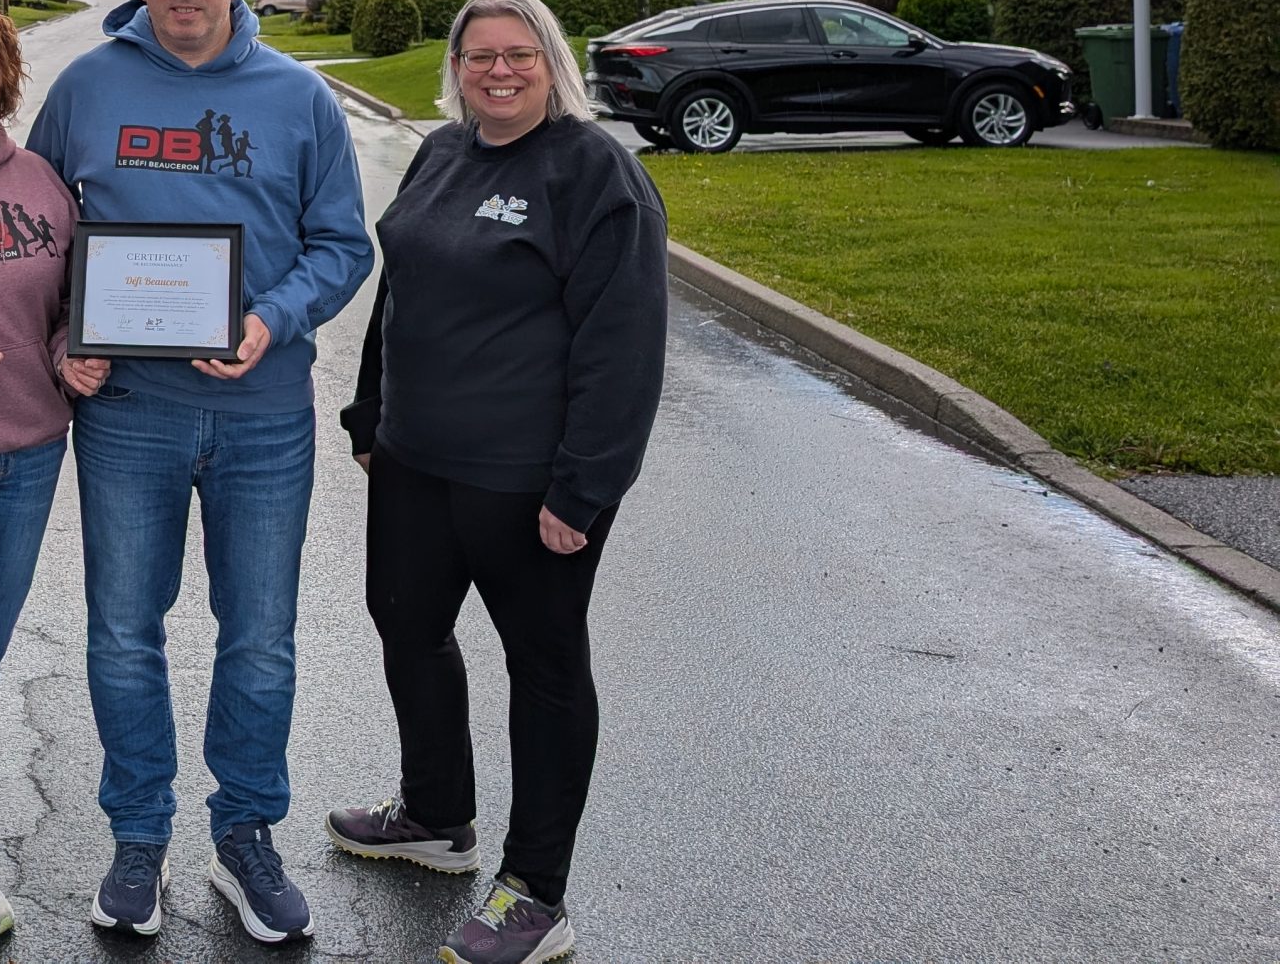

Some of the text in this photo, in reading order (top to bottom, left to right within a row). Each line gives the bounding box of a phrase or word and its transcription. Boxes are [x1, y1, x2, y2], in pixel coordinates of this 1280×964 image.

[119, 126, 202, 162] DB
[129, 159, 147, 167] DÉFI
[148, 161, 200, 171] BEAUCERON
[126, 252, 190, 263] CERTIFICAT
[125, 276, 189, 288] Défi Beauceron
